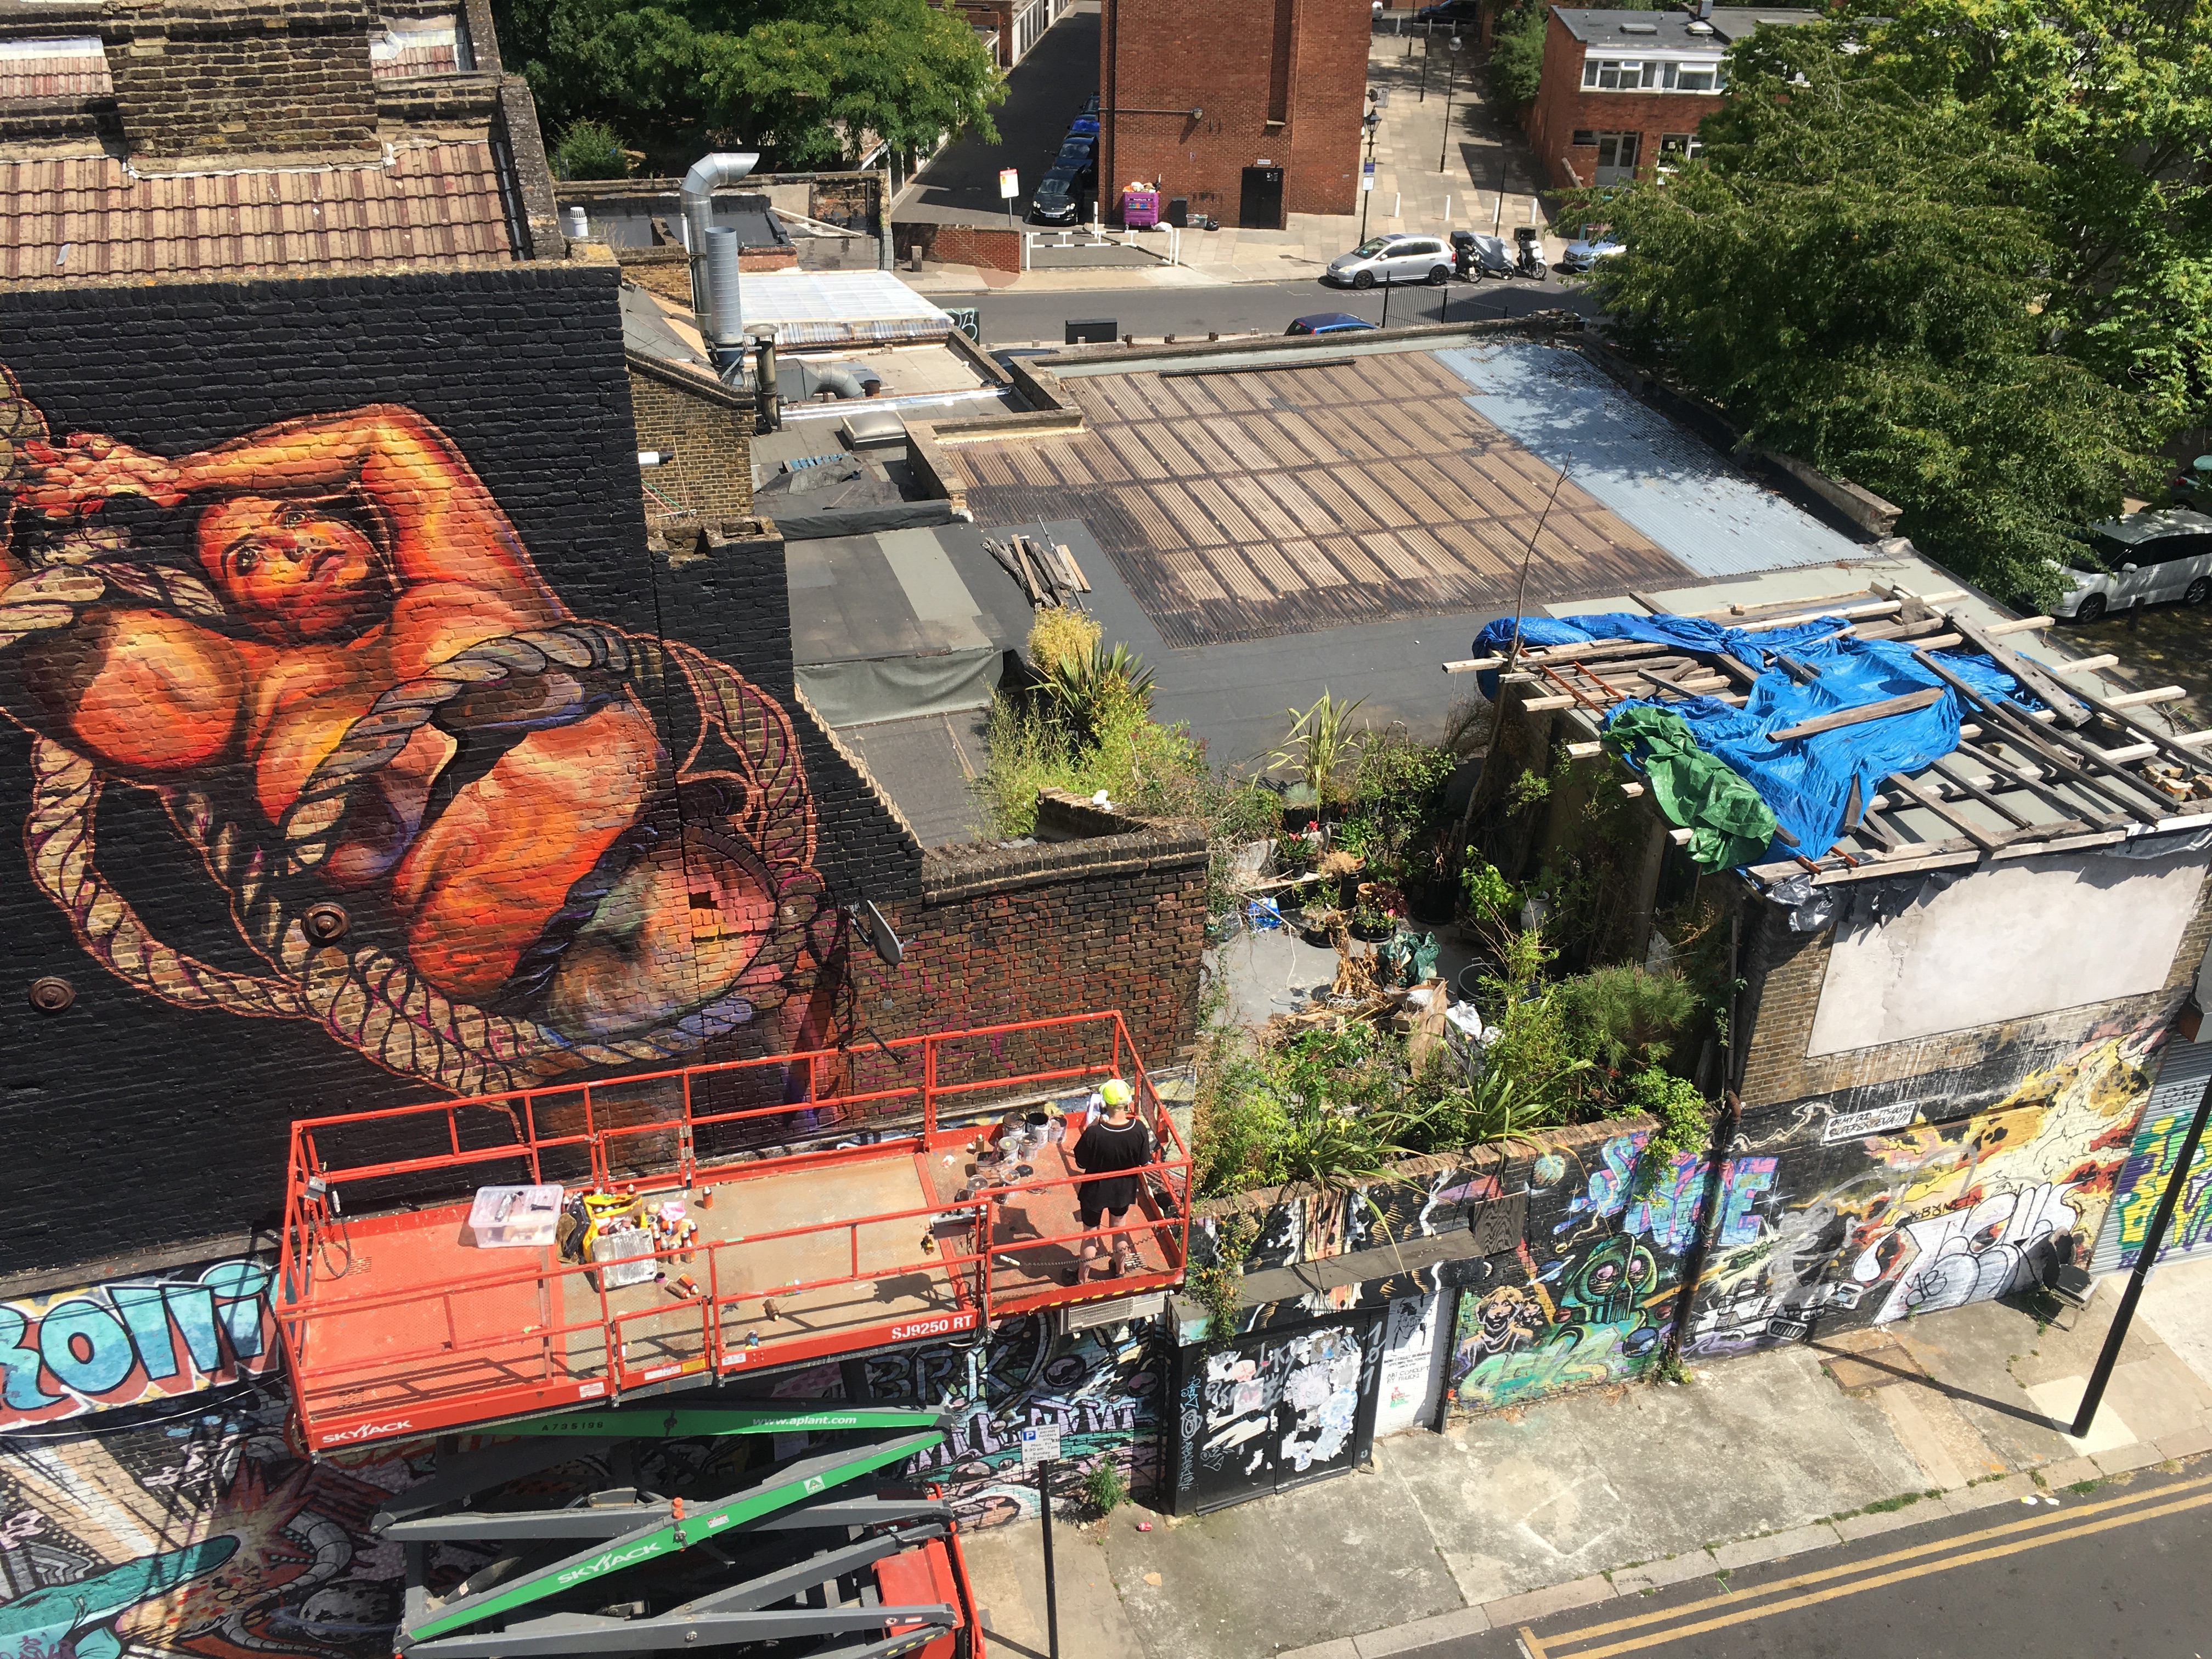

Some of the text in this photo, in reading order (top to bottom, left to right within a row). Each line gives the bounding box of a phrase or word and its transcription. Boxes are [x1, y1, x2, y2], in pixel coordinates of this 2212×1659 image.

[891, 1314, 973, 1339] SJ9250 RT
[1400, 1365, 1430, 1376] CONCEPT
[753, 1416, 856, 1426] www.aplant.com
[322, 1420, 413, 1443] SKYJACK
[1026, 1431, 1034, 1440] P
[557, 1542, 662, 1583] SKYJACK
